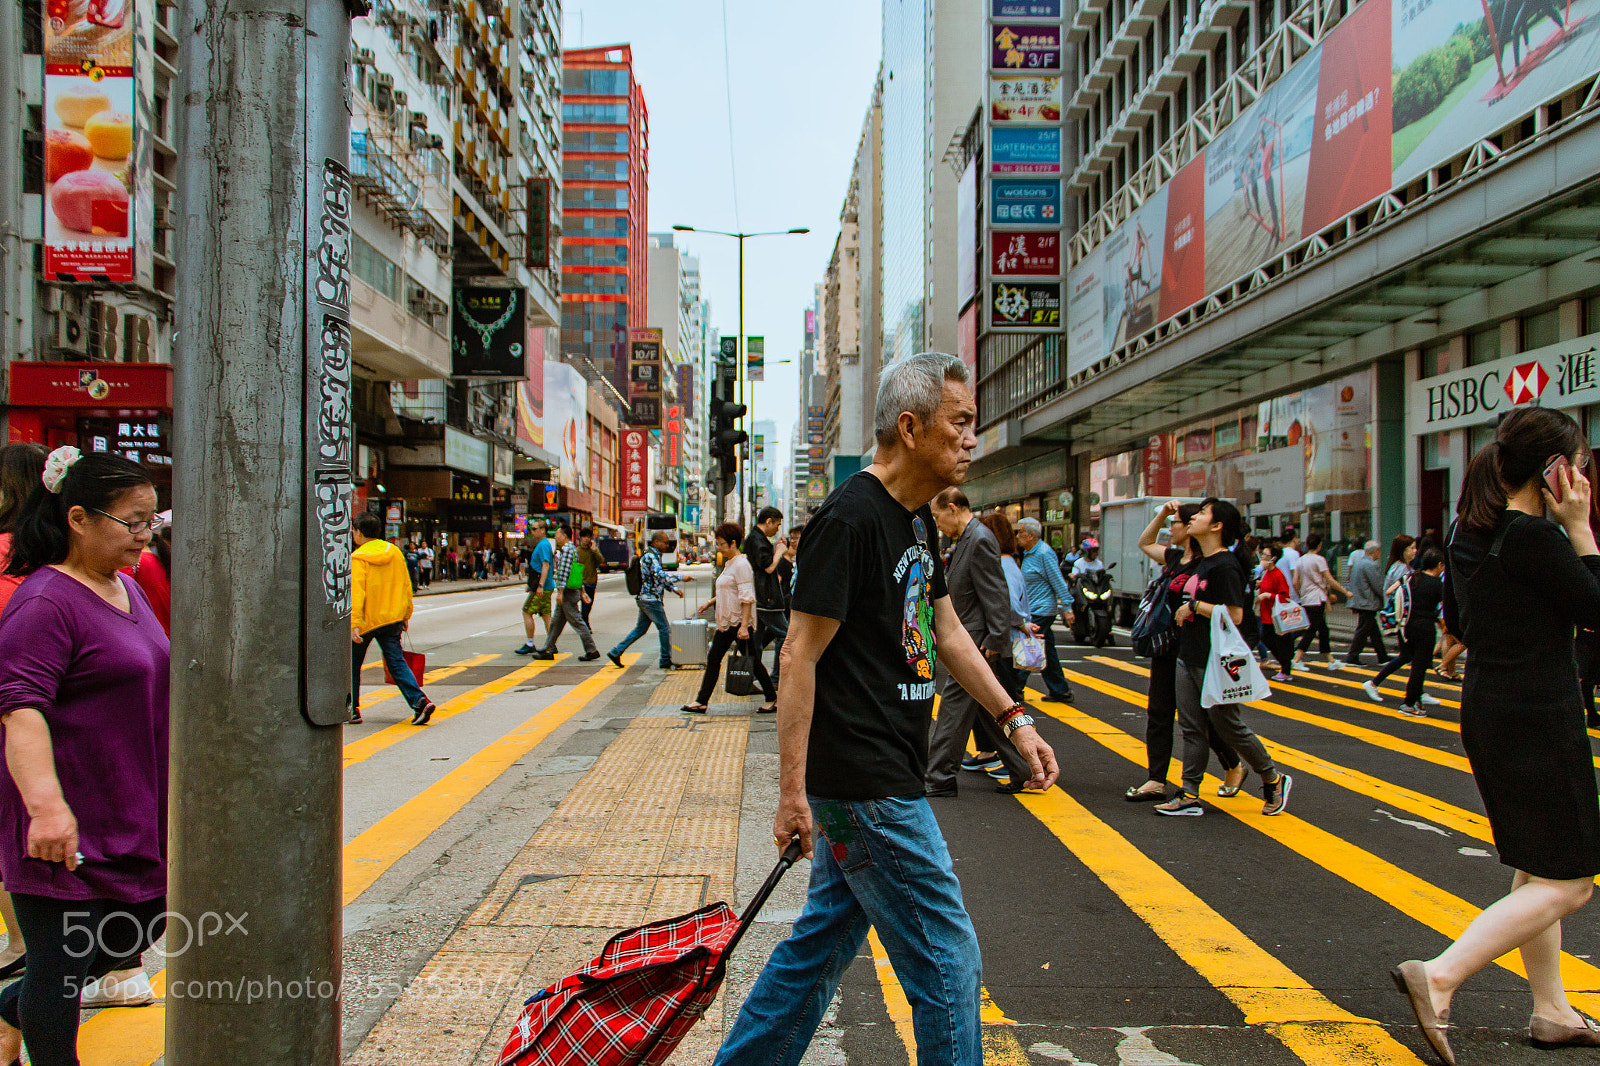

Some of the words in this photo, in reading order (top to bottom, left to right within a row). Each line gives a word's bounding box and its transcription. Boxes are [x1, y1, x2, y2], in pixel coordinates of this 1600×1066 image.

[1028, 53, 1054, 68] 3/F
[994, 143, 1058, 151] WATERHOUSE
[1004, 189, 1047, 197] watsons
[997, 205, 1036, 218] 屈臣氏
[1038, 236, 1056, 248] 2/F
[634, 350, 657, 360] 10/F
[1427, 370, 1500, 423] HSBC
[893, 551, 909, 584] NEW
[1223, 684, 1252, 694] dokidoki
